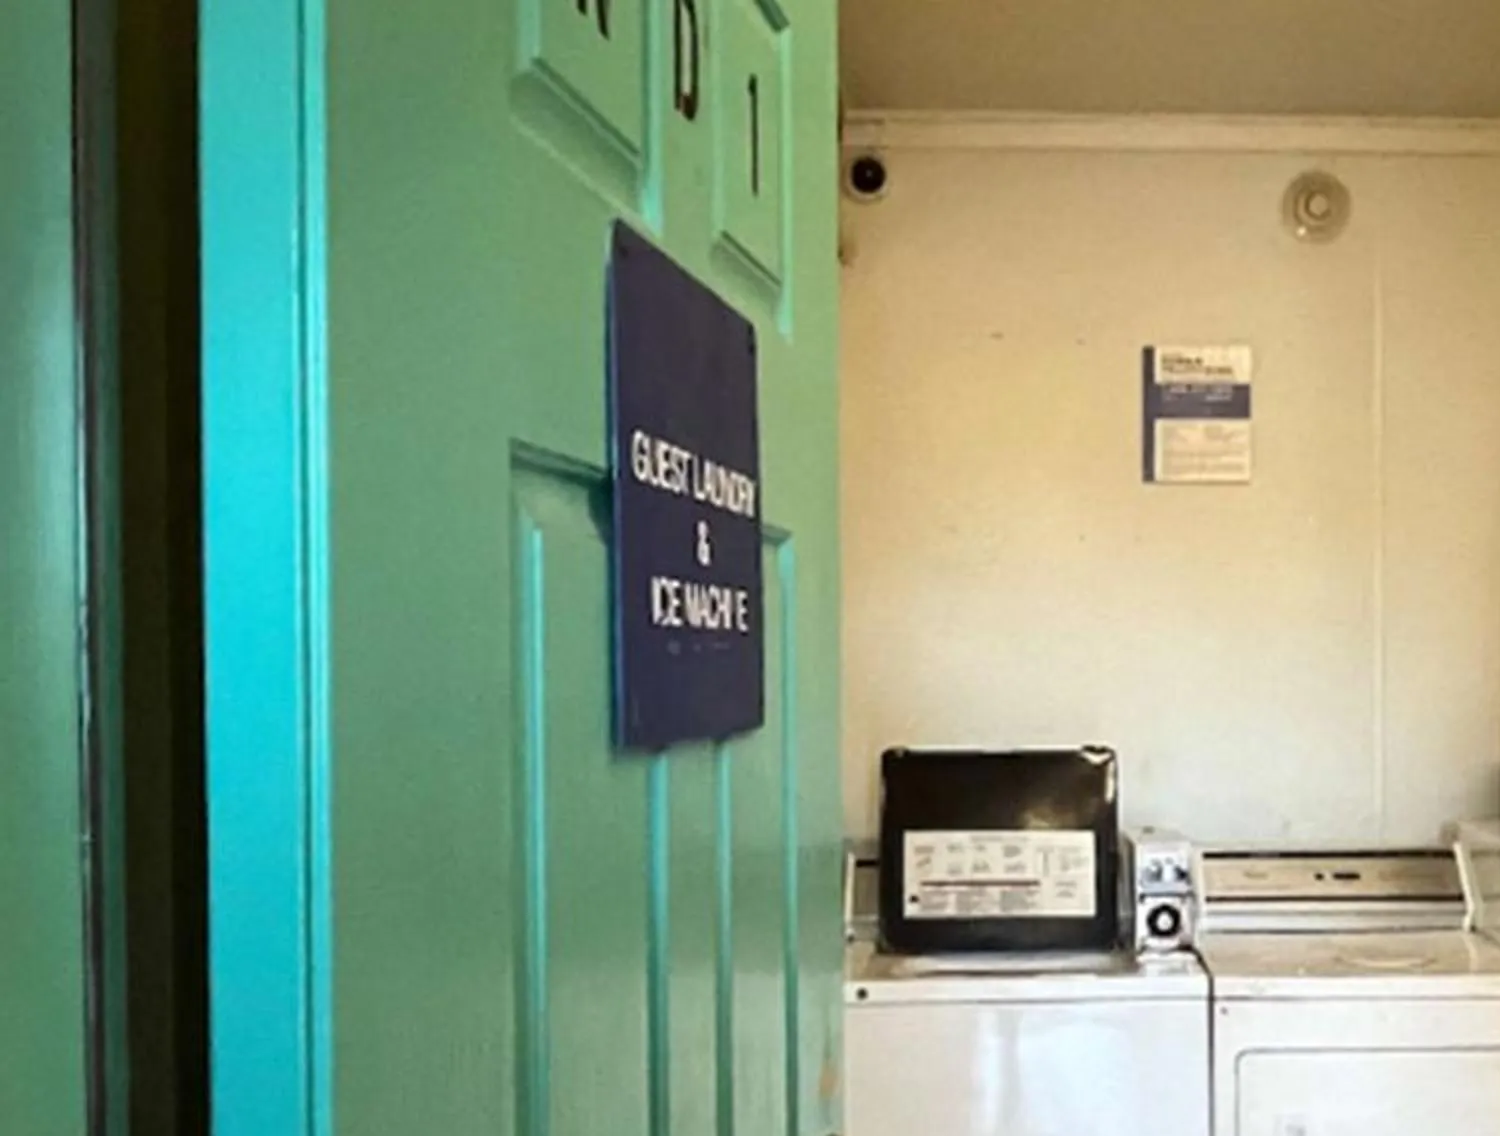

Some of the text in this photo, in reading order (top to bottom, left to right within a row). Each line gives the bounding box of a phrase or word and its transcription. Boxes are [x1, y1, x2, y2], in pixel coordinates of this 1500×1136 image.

[630, 429, 758, 519] GUEST LAUNDRY
[696, 519, 712, 567] &
[650, 575, 683, 628] ICE
